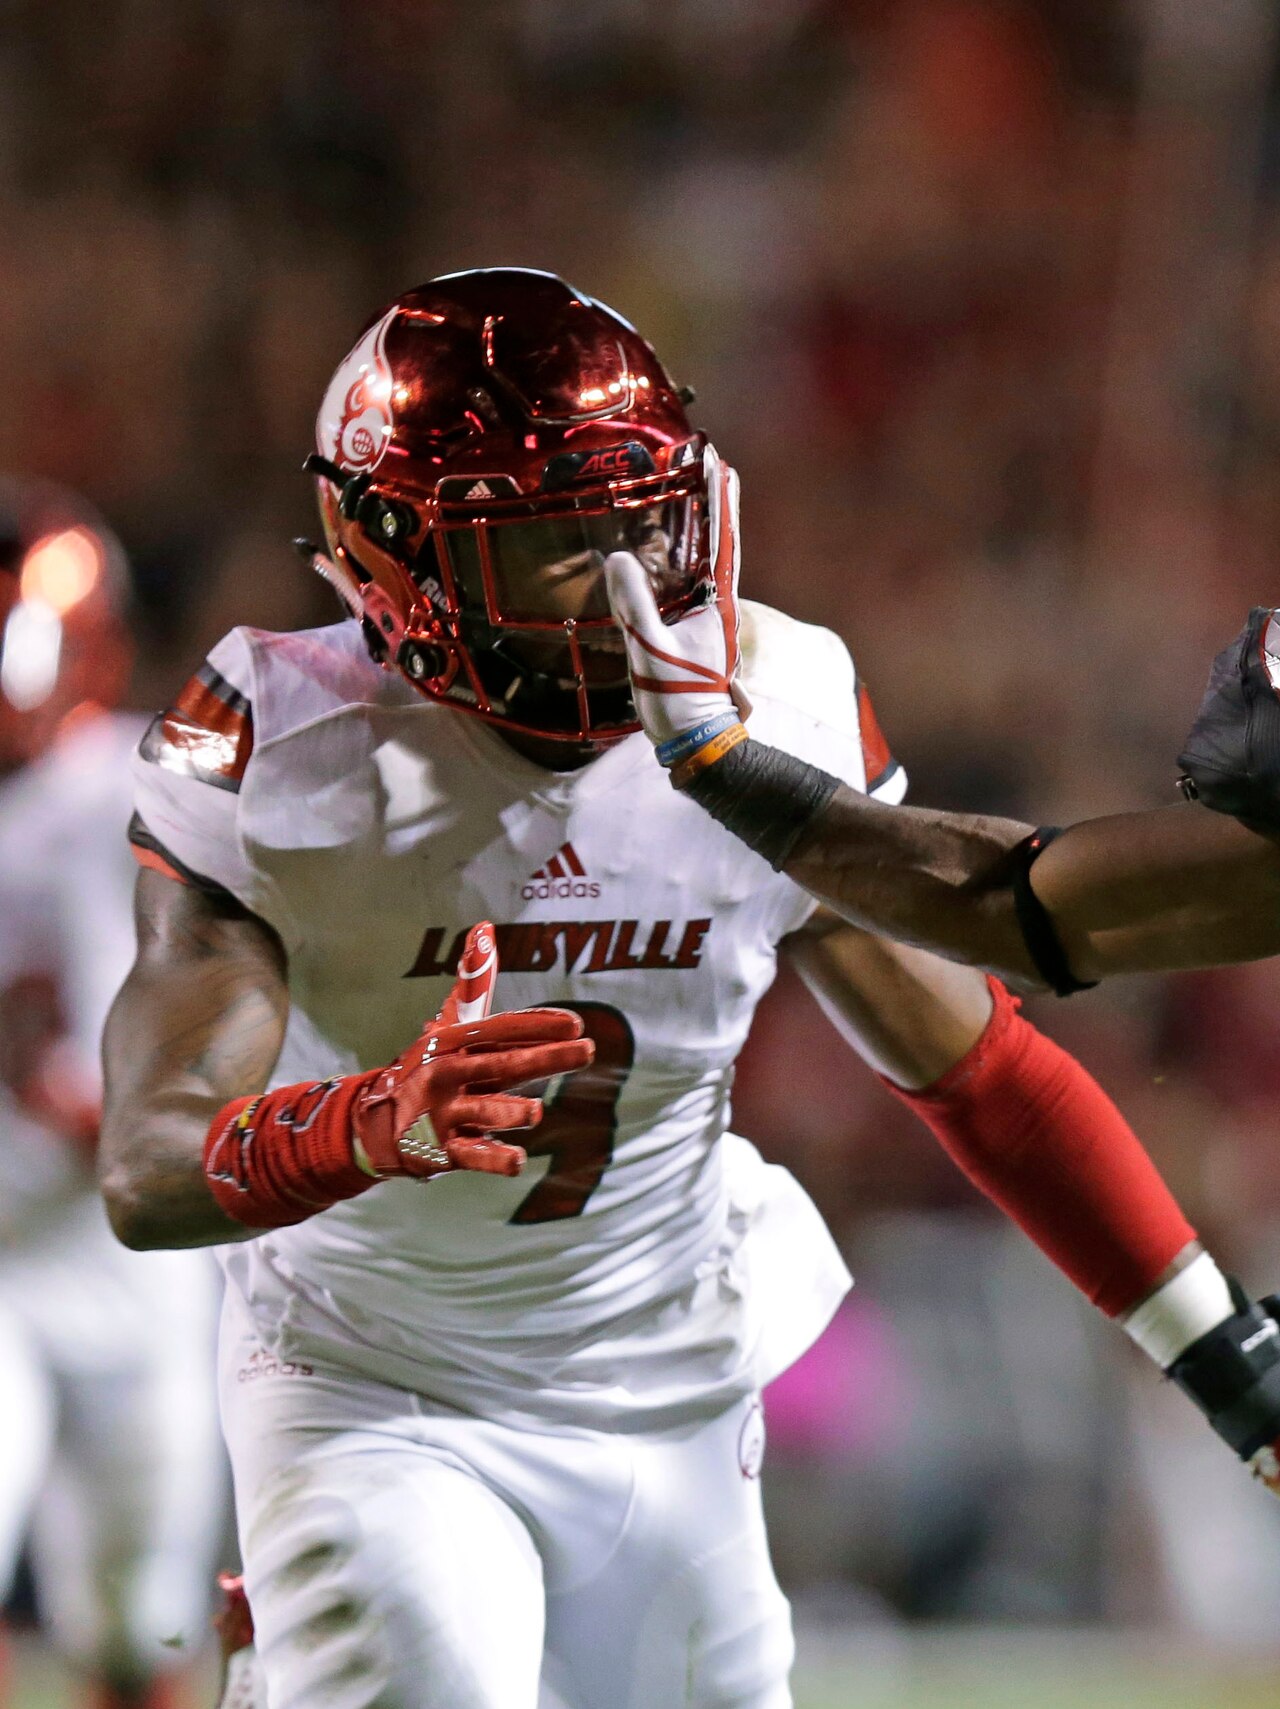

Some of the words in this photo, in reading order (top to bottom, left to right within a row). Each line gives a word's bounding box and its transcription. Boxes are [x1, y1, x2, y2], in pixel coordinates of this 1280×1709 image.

[578, 448, 630, 475] ACC
[521, 877, 601, 901] adidas
[488, 1000, 635, 1226] 9
